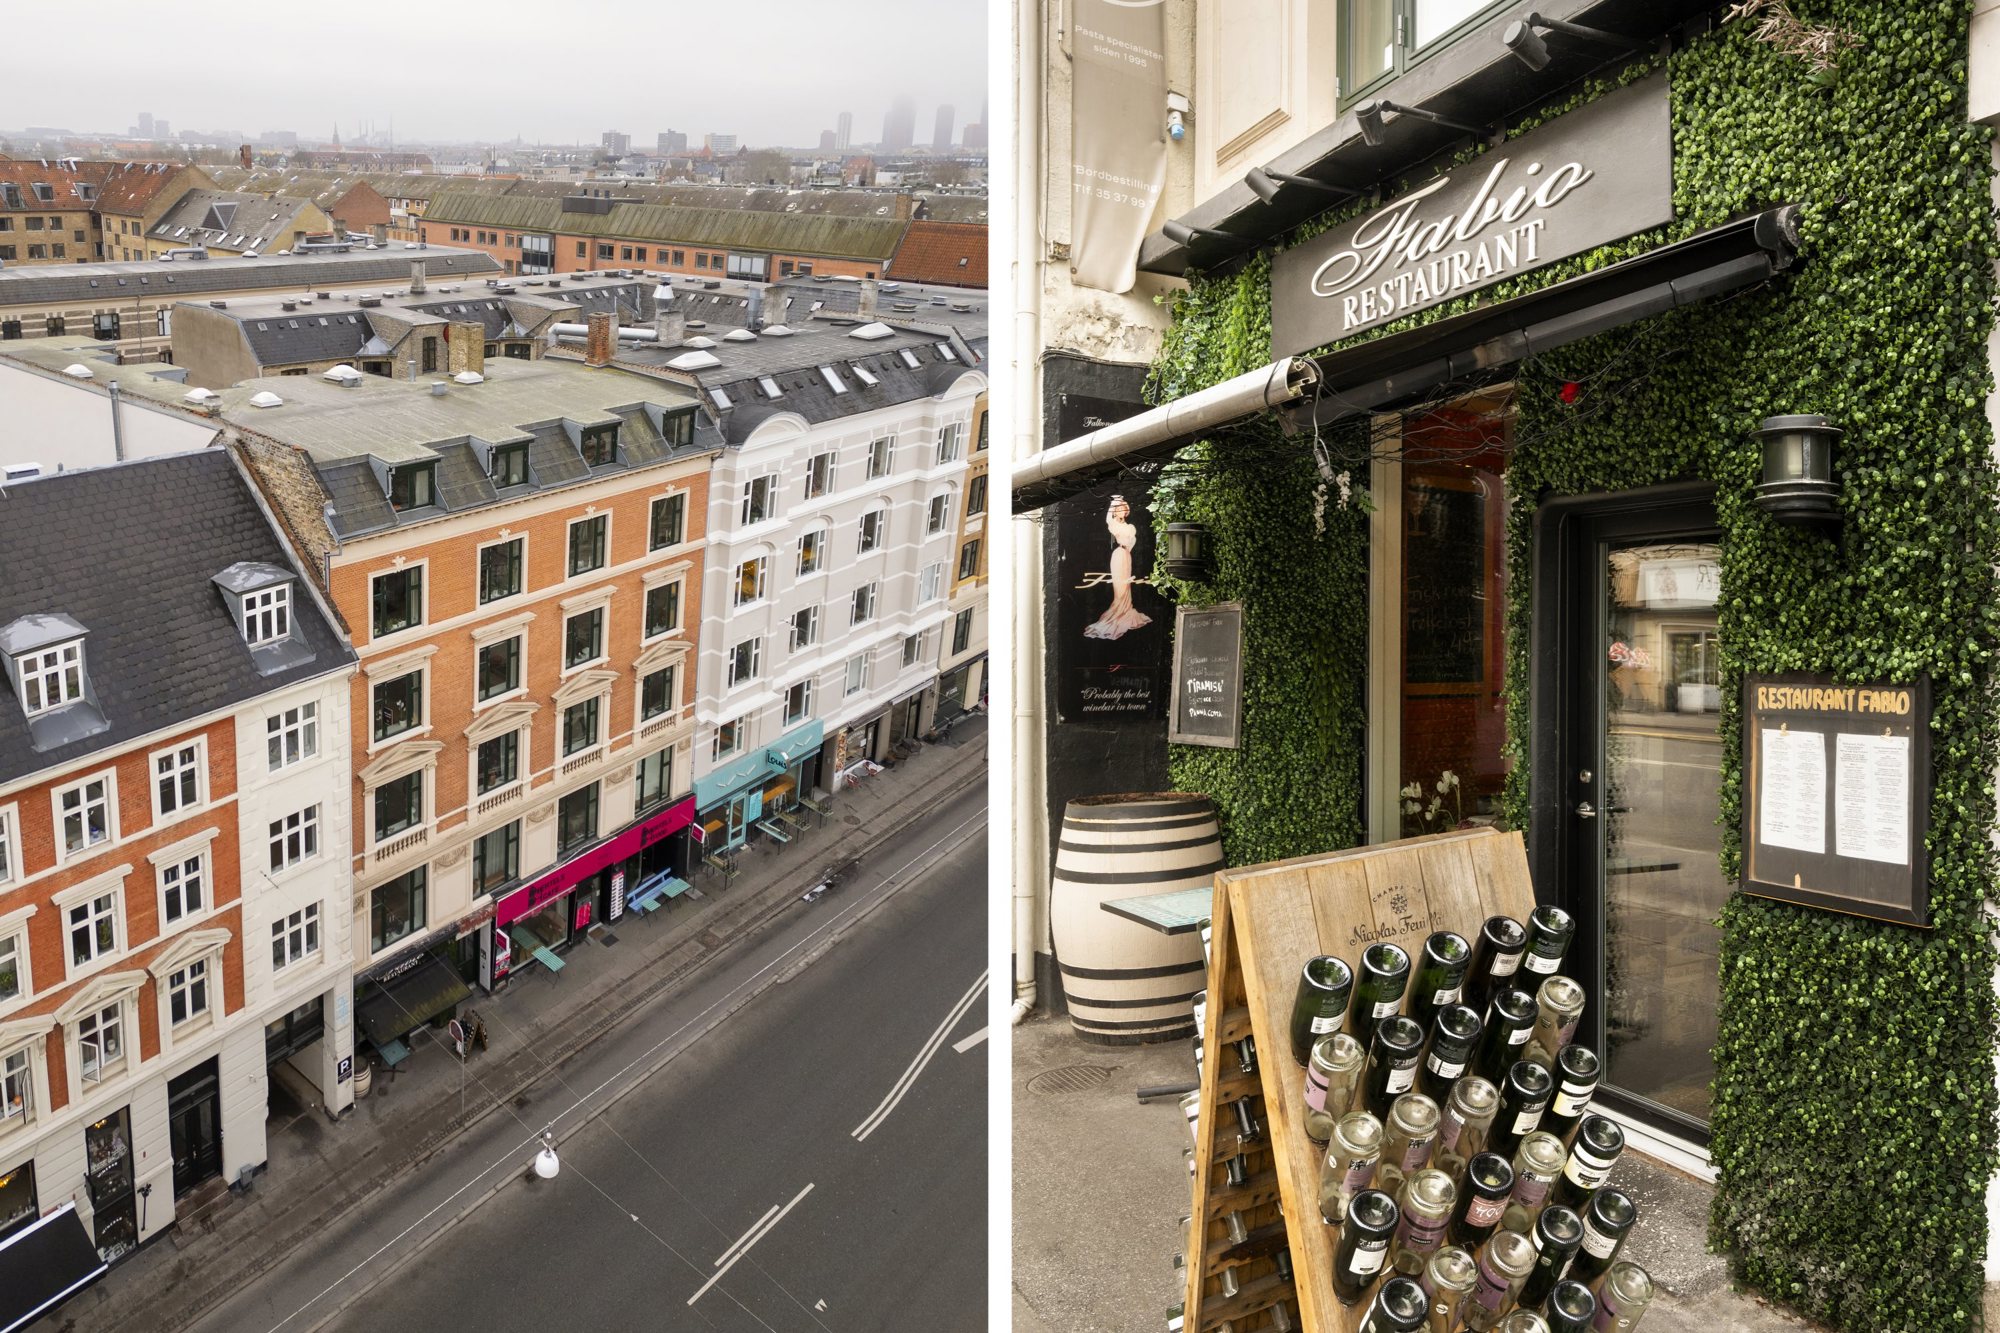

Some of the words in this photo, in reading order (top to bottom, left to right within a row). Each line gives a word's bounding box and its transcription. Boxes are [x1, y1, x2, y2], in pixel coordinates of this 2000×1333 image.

[1075, 24, 1104, 41] Pasta
[1107, 36, 1164, 61] specialisten
[1093, 44, 1120, 59] siden
[1123, 53, 1147, 67] 1995
[1096, 188, 1111, 200] 35
[1113, 192, 1128, 203] 37
[1131, 197, 1146, 208] 99
[1311, 158, 1594, 297] Fabio
[1342, 219, 1545, 331] RESTAURANT
[1124, 689, 1136, 699] the
[1137, 689, 1151, 699] best
[1757, 686, 1856, 712] RESTAURANT
[1858, 690, 1910, 715] FABIO
[1083, 702, 1116, 712] winebar
[1117, 703, 1125, 711] in
[1349, 923, 1397, 946] Nicolas
[340, 1060, 350, 1074] P
